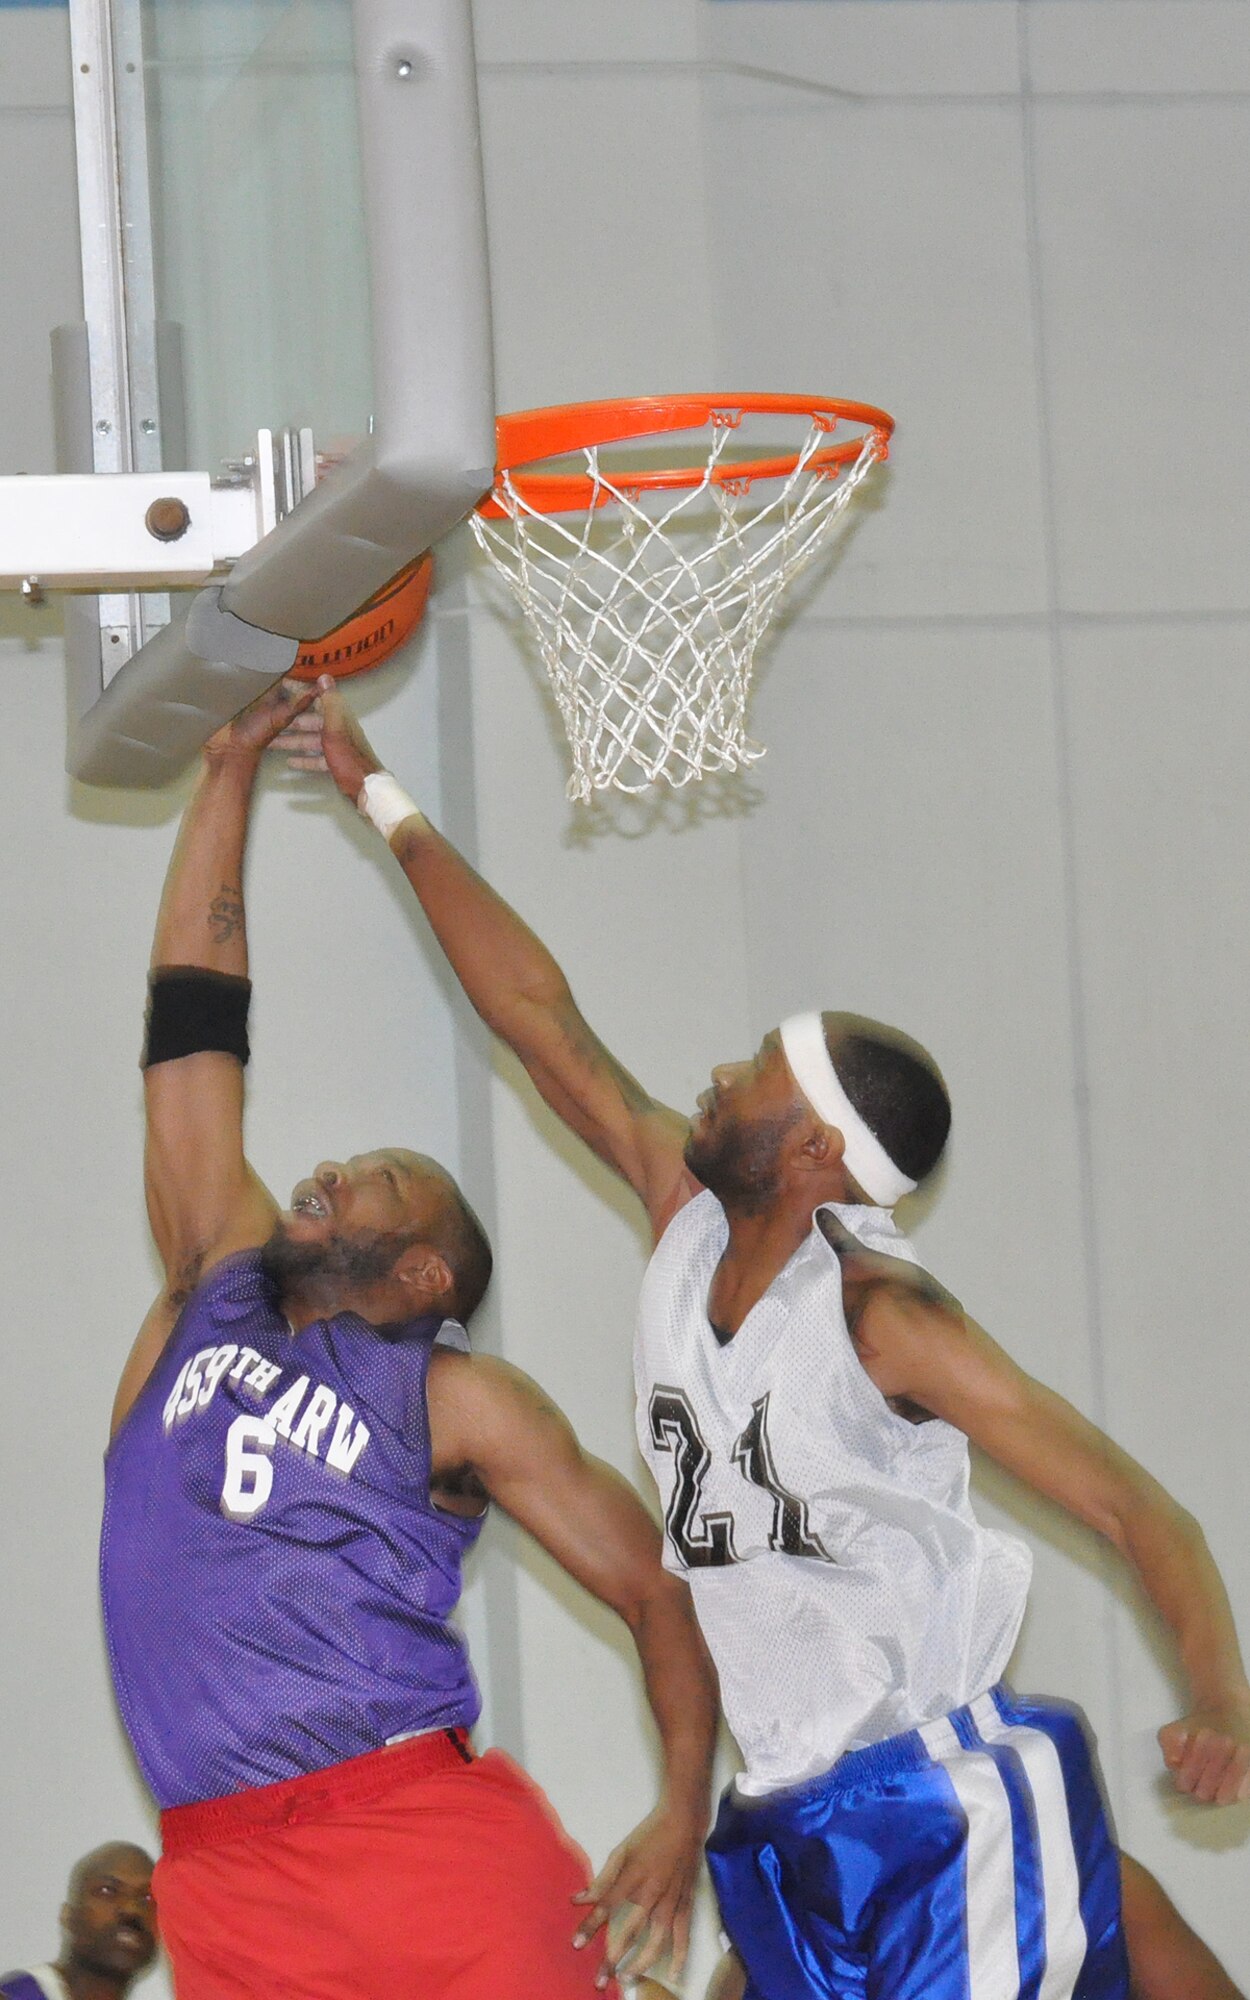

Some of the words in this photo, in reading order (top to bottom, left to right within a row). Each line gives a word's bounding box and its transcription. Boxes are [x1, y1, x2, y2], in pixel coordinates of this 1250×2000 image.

[162, 1344, 283, 1431] 459TH
[263, 1374, 371, 1475] ARW
[221, 1414, 278, 1515] 6
[648, 1383, 838, 1569] 21
